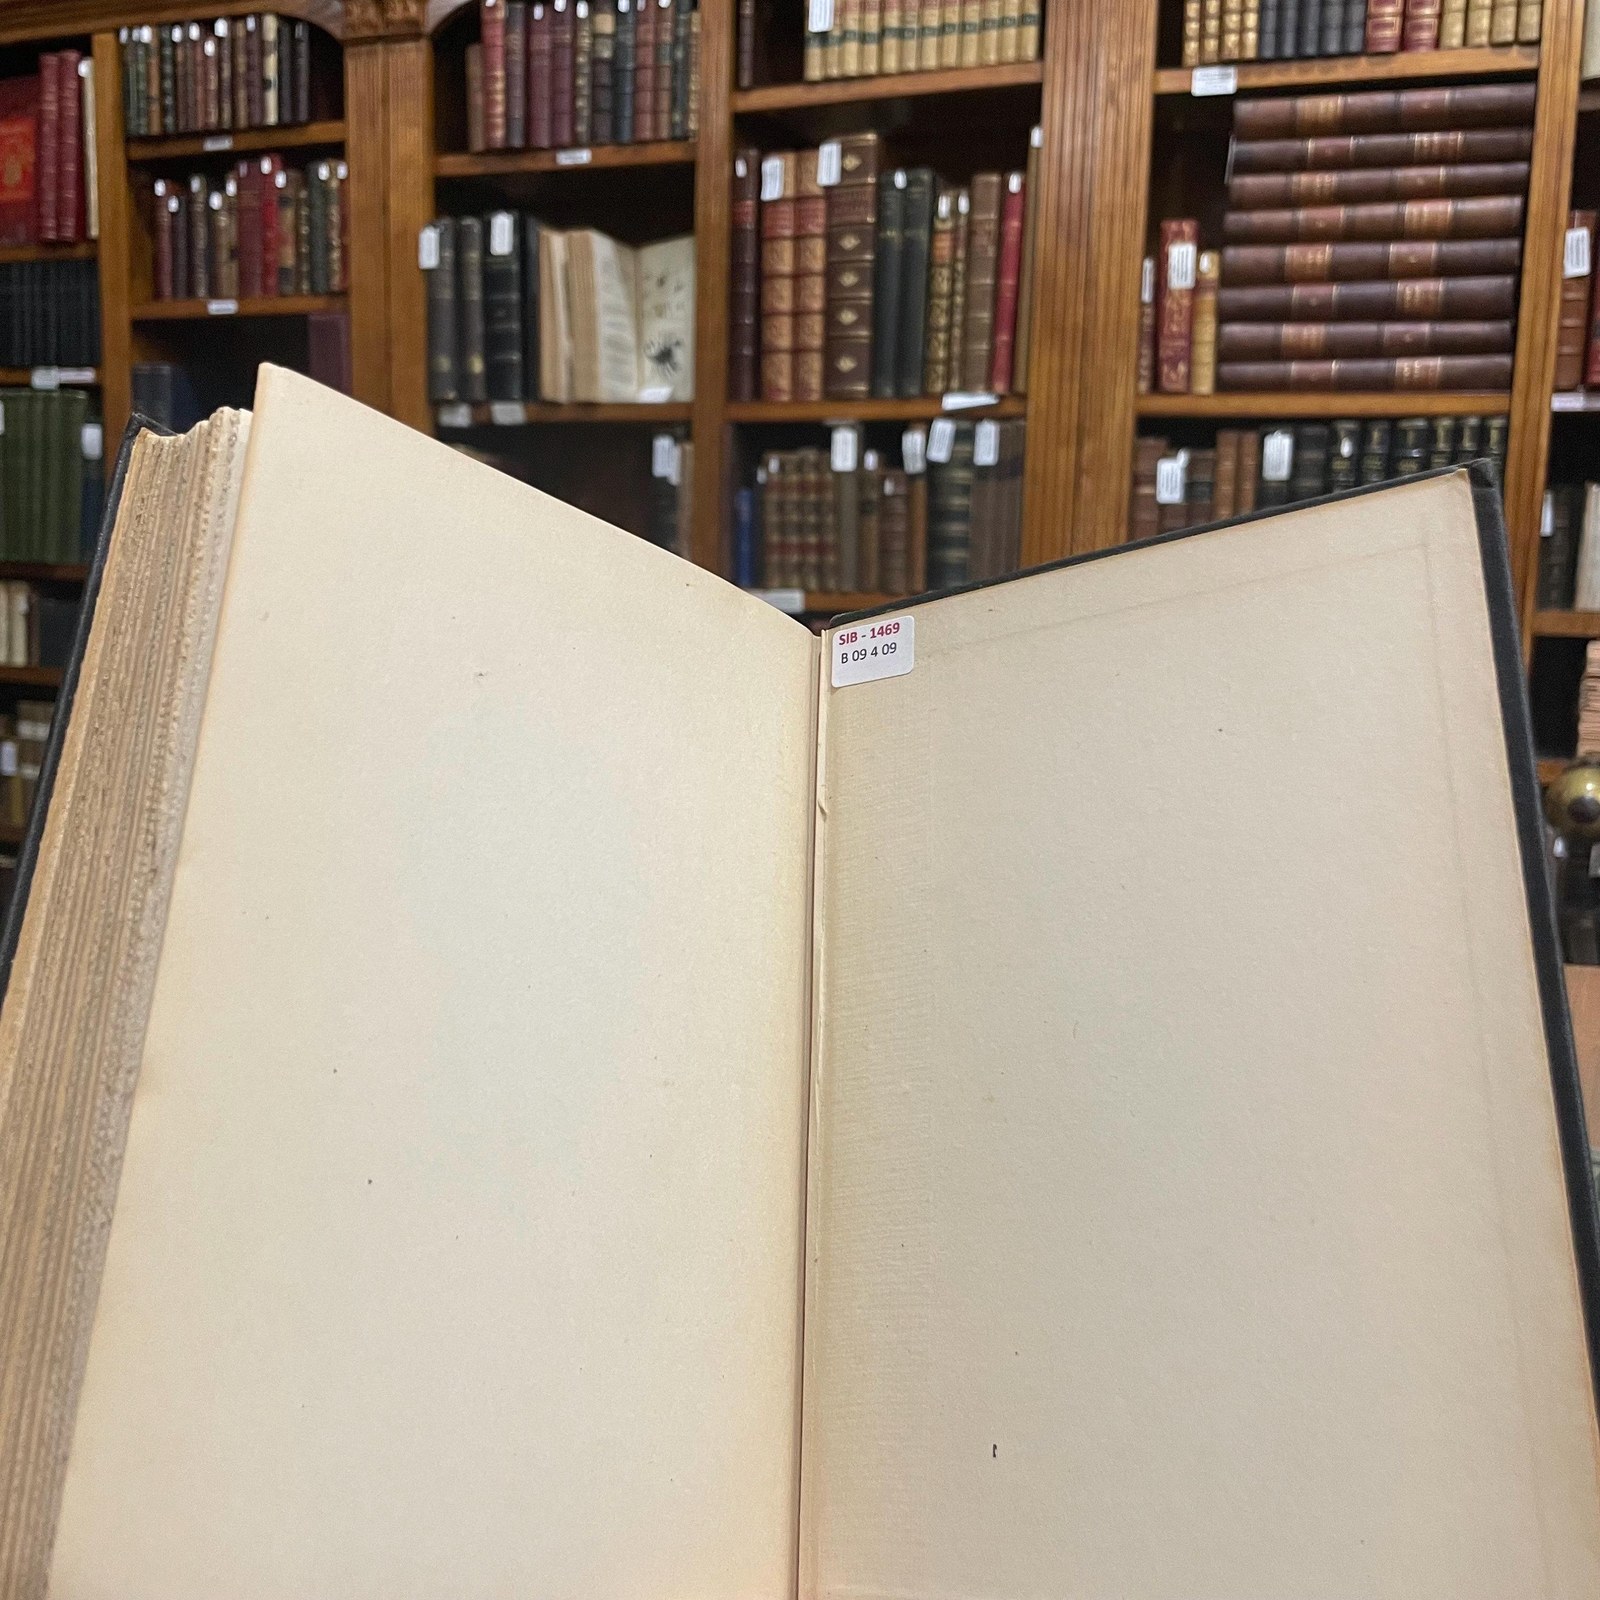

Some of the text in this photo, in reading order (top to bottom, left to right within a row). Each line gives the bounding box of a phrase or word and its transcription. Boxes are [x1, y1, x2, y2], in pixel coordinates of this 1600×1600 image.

[838, 631, 858, 645] SIB
[869, 622, 900, 639] 1469
[841, 642, 897, 664] B 09 4 09
